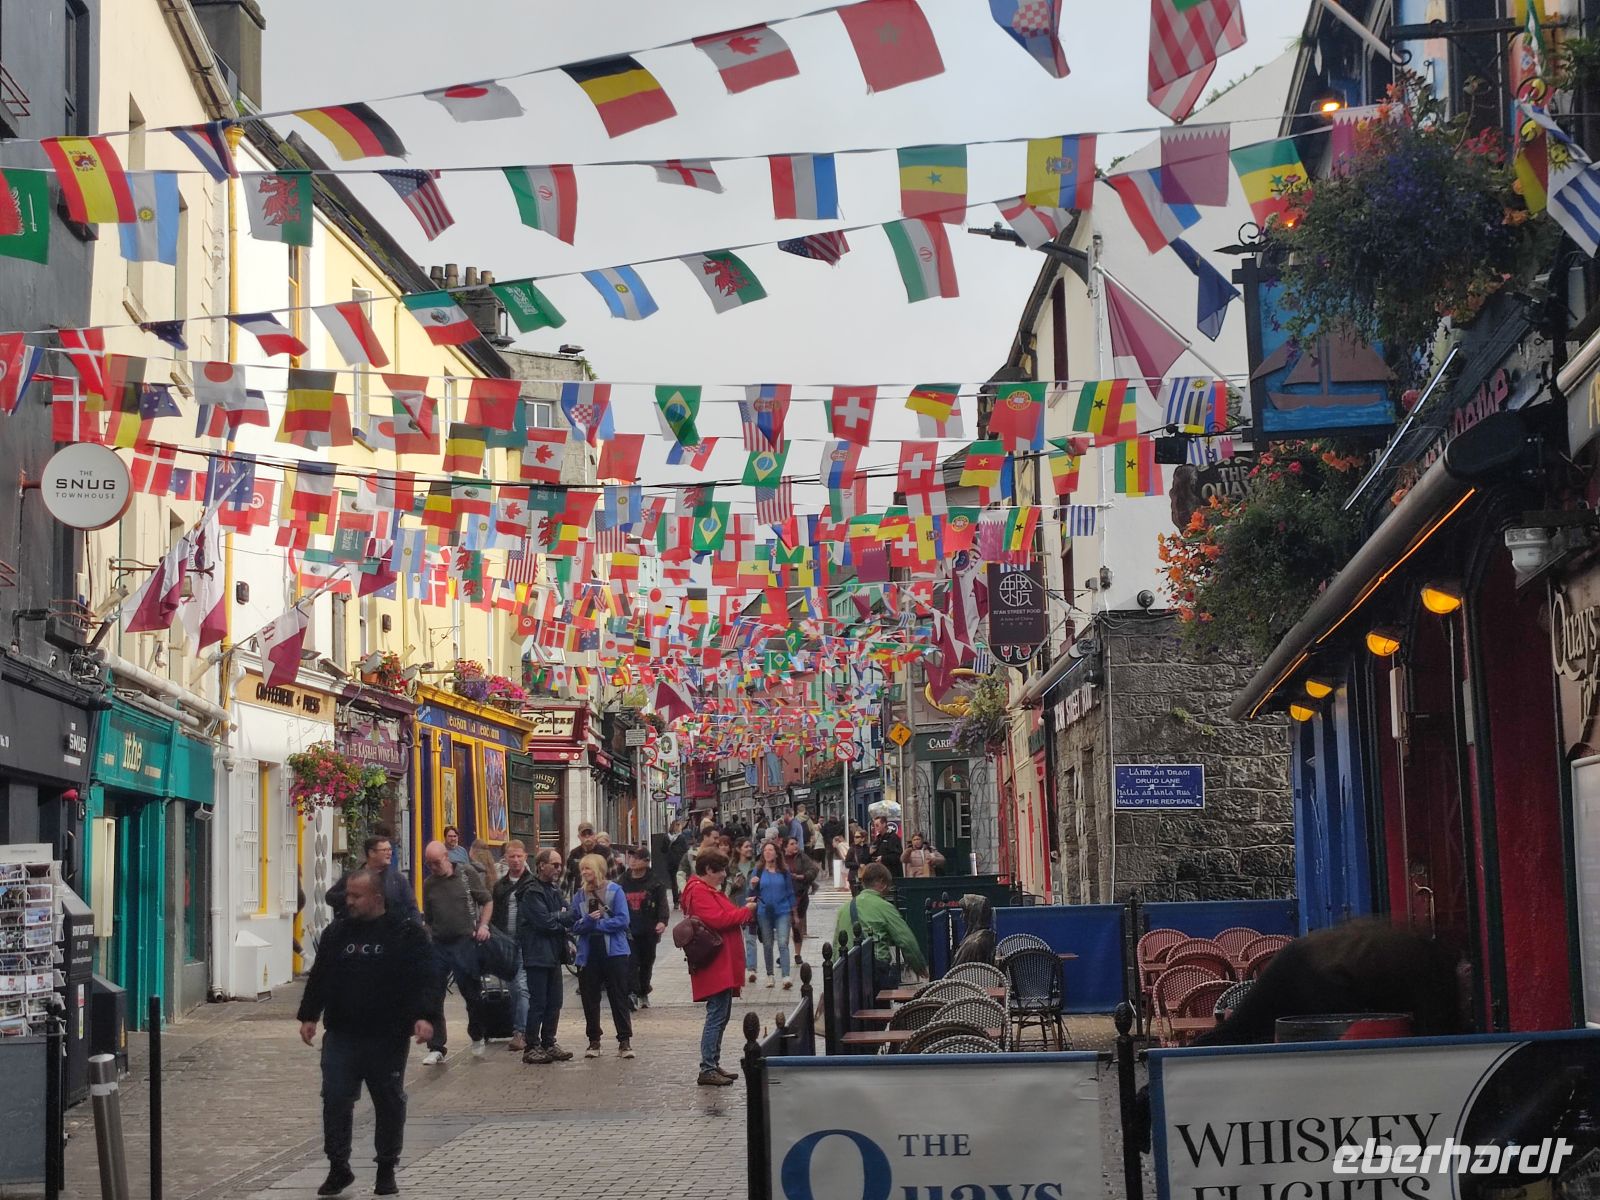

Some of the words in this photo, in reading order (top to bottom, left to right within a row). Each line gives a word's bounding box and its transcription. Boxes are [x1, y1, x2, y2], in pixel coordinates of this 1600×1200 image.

[1217, 465, 1248, 482] THE
[56, 478, 116, 490] SNUG
[69, 733, 87, 753] SNUG
[898, 1133, 972, 1157] THE
[1174, 1112, 1442, 1168] WHISKEY
